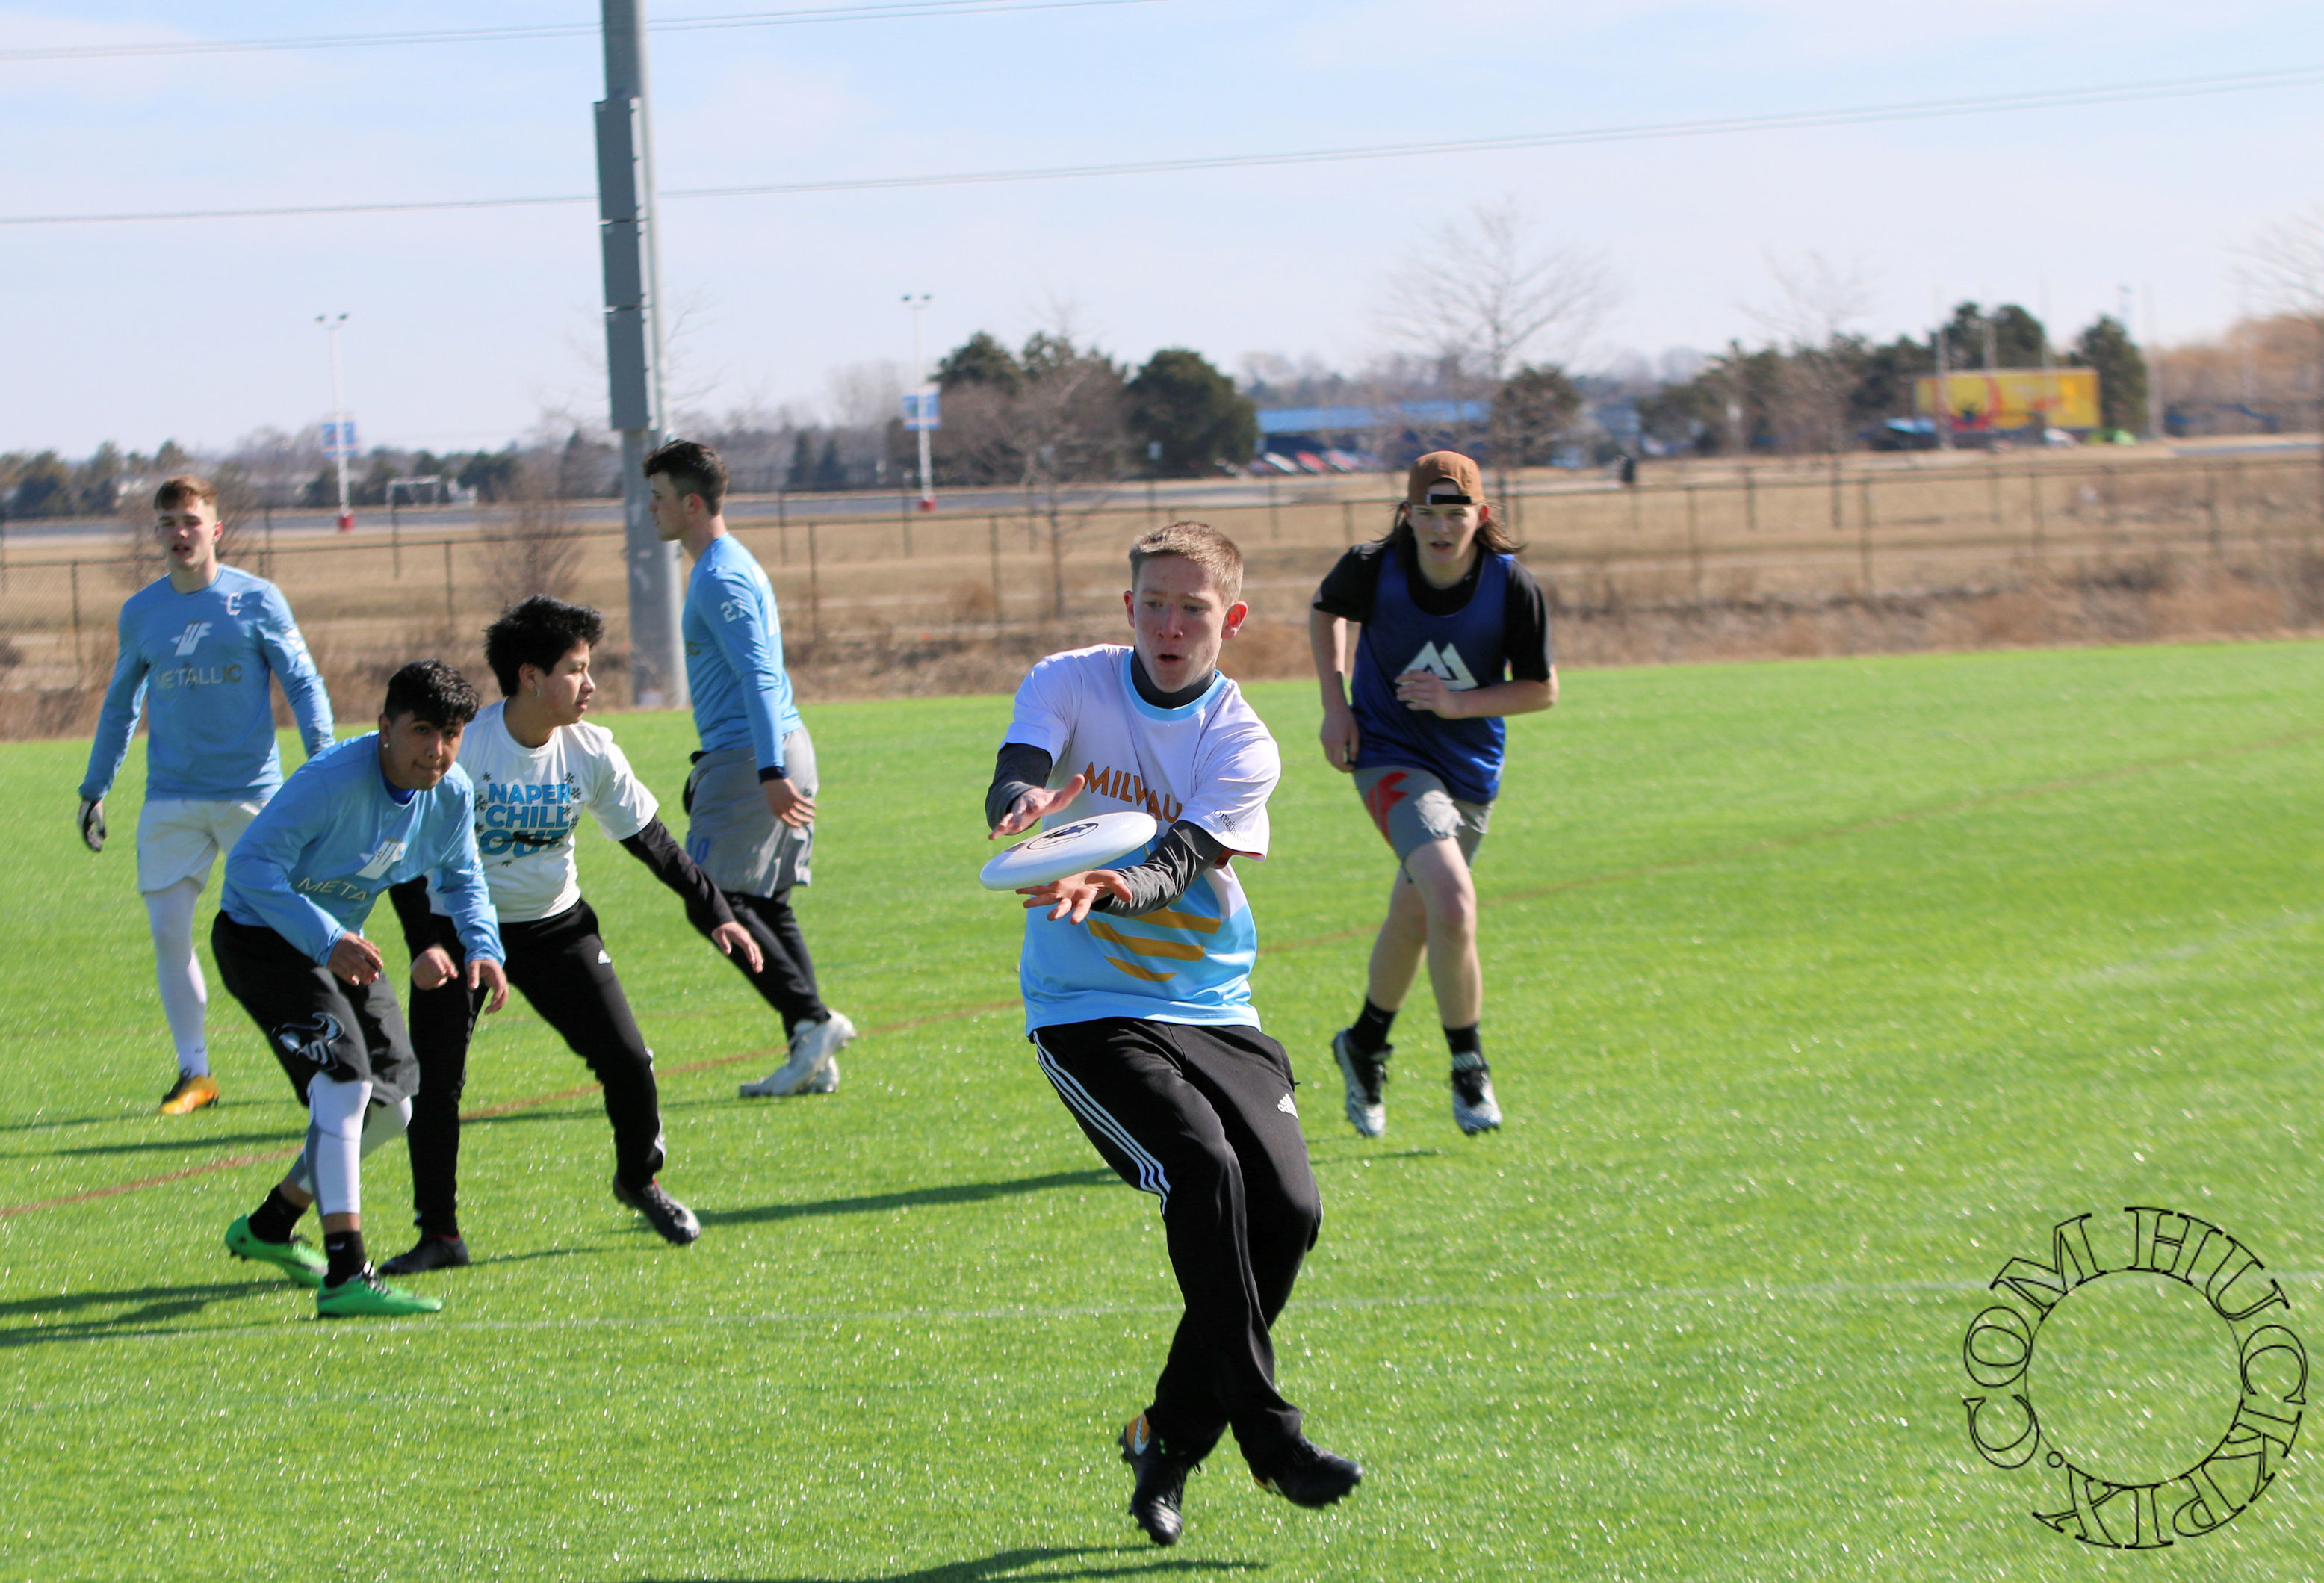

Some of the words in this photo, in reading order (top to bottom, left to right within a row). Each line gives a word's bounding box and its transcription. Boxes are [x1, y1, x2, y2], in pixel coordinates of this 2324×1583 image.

[488, 783, 571, 805] NAPER
[485, 804, 570, 829] CHILL
[479, 828, 569, 858] OUT
[297, 876, 367, 901] META
